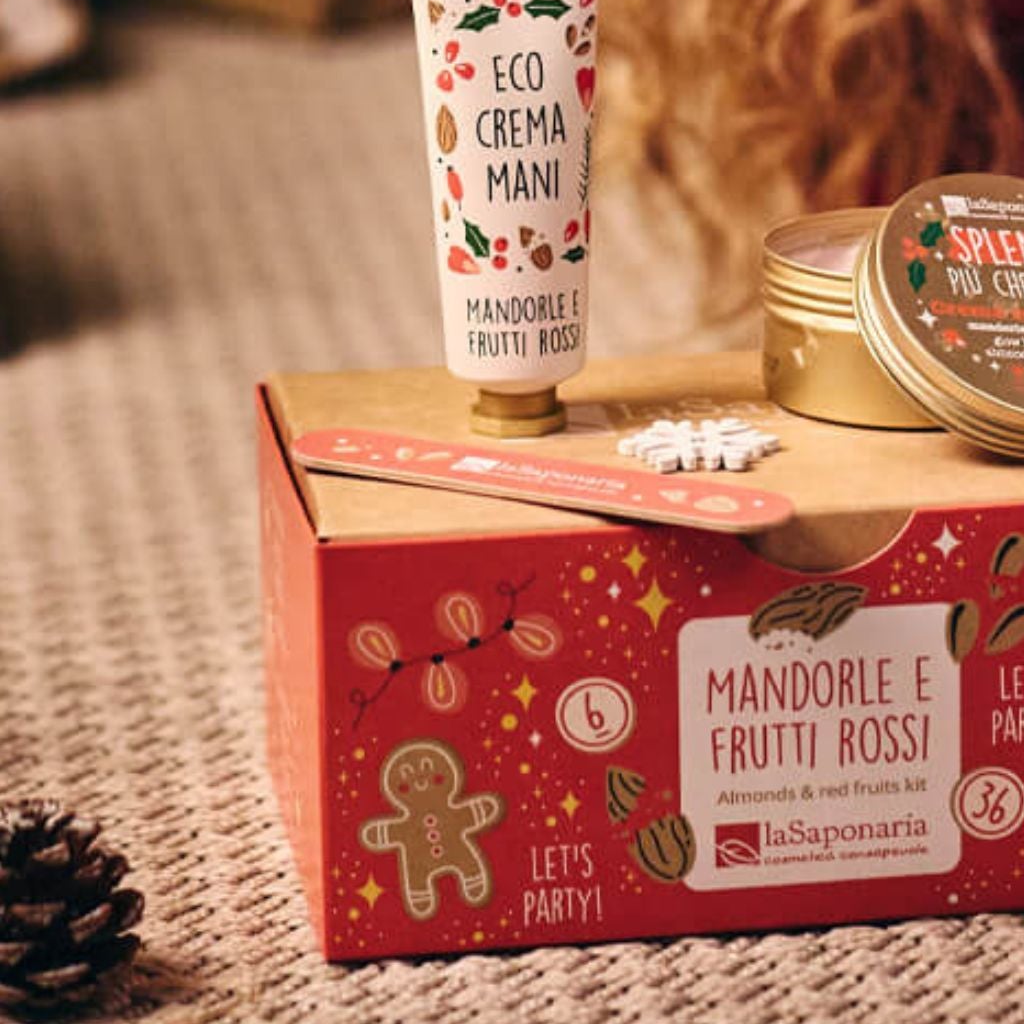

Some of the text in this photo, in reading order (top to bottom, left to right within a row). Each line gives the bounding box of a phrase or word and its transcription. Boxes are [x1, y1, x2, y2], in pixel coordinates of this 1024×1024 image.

[493, 51, 544, 92] ECO
[476, 102, 567, 150] CREMA
[487, 158, 560, 203] MANI
[467, 289, 579, 325] MANDORLE E
[468, 330, 526, 358] FRUTTI
[706, 656, 932, 715] MANDORLE E
[585, 691, 608, 734] 6
[710, 713, 930, 774] FRUTTI ROSSI
[717, 777, 928, 806] Almonds & red fruits kit
[972, 780, 1011, 824] 36
[764, 813, 929, 849] laSaponaria
[531, 843, 594, 882] LET'S
[523, 885, 604, 927] PARTY!
